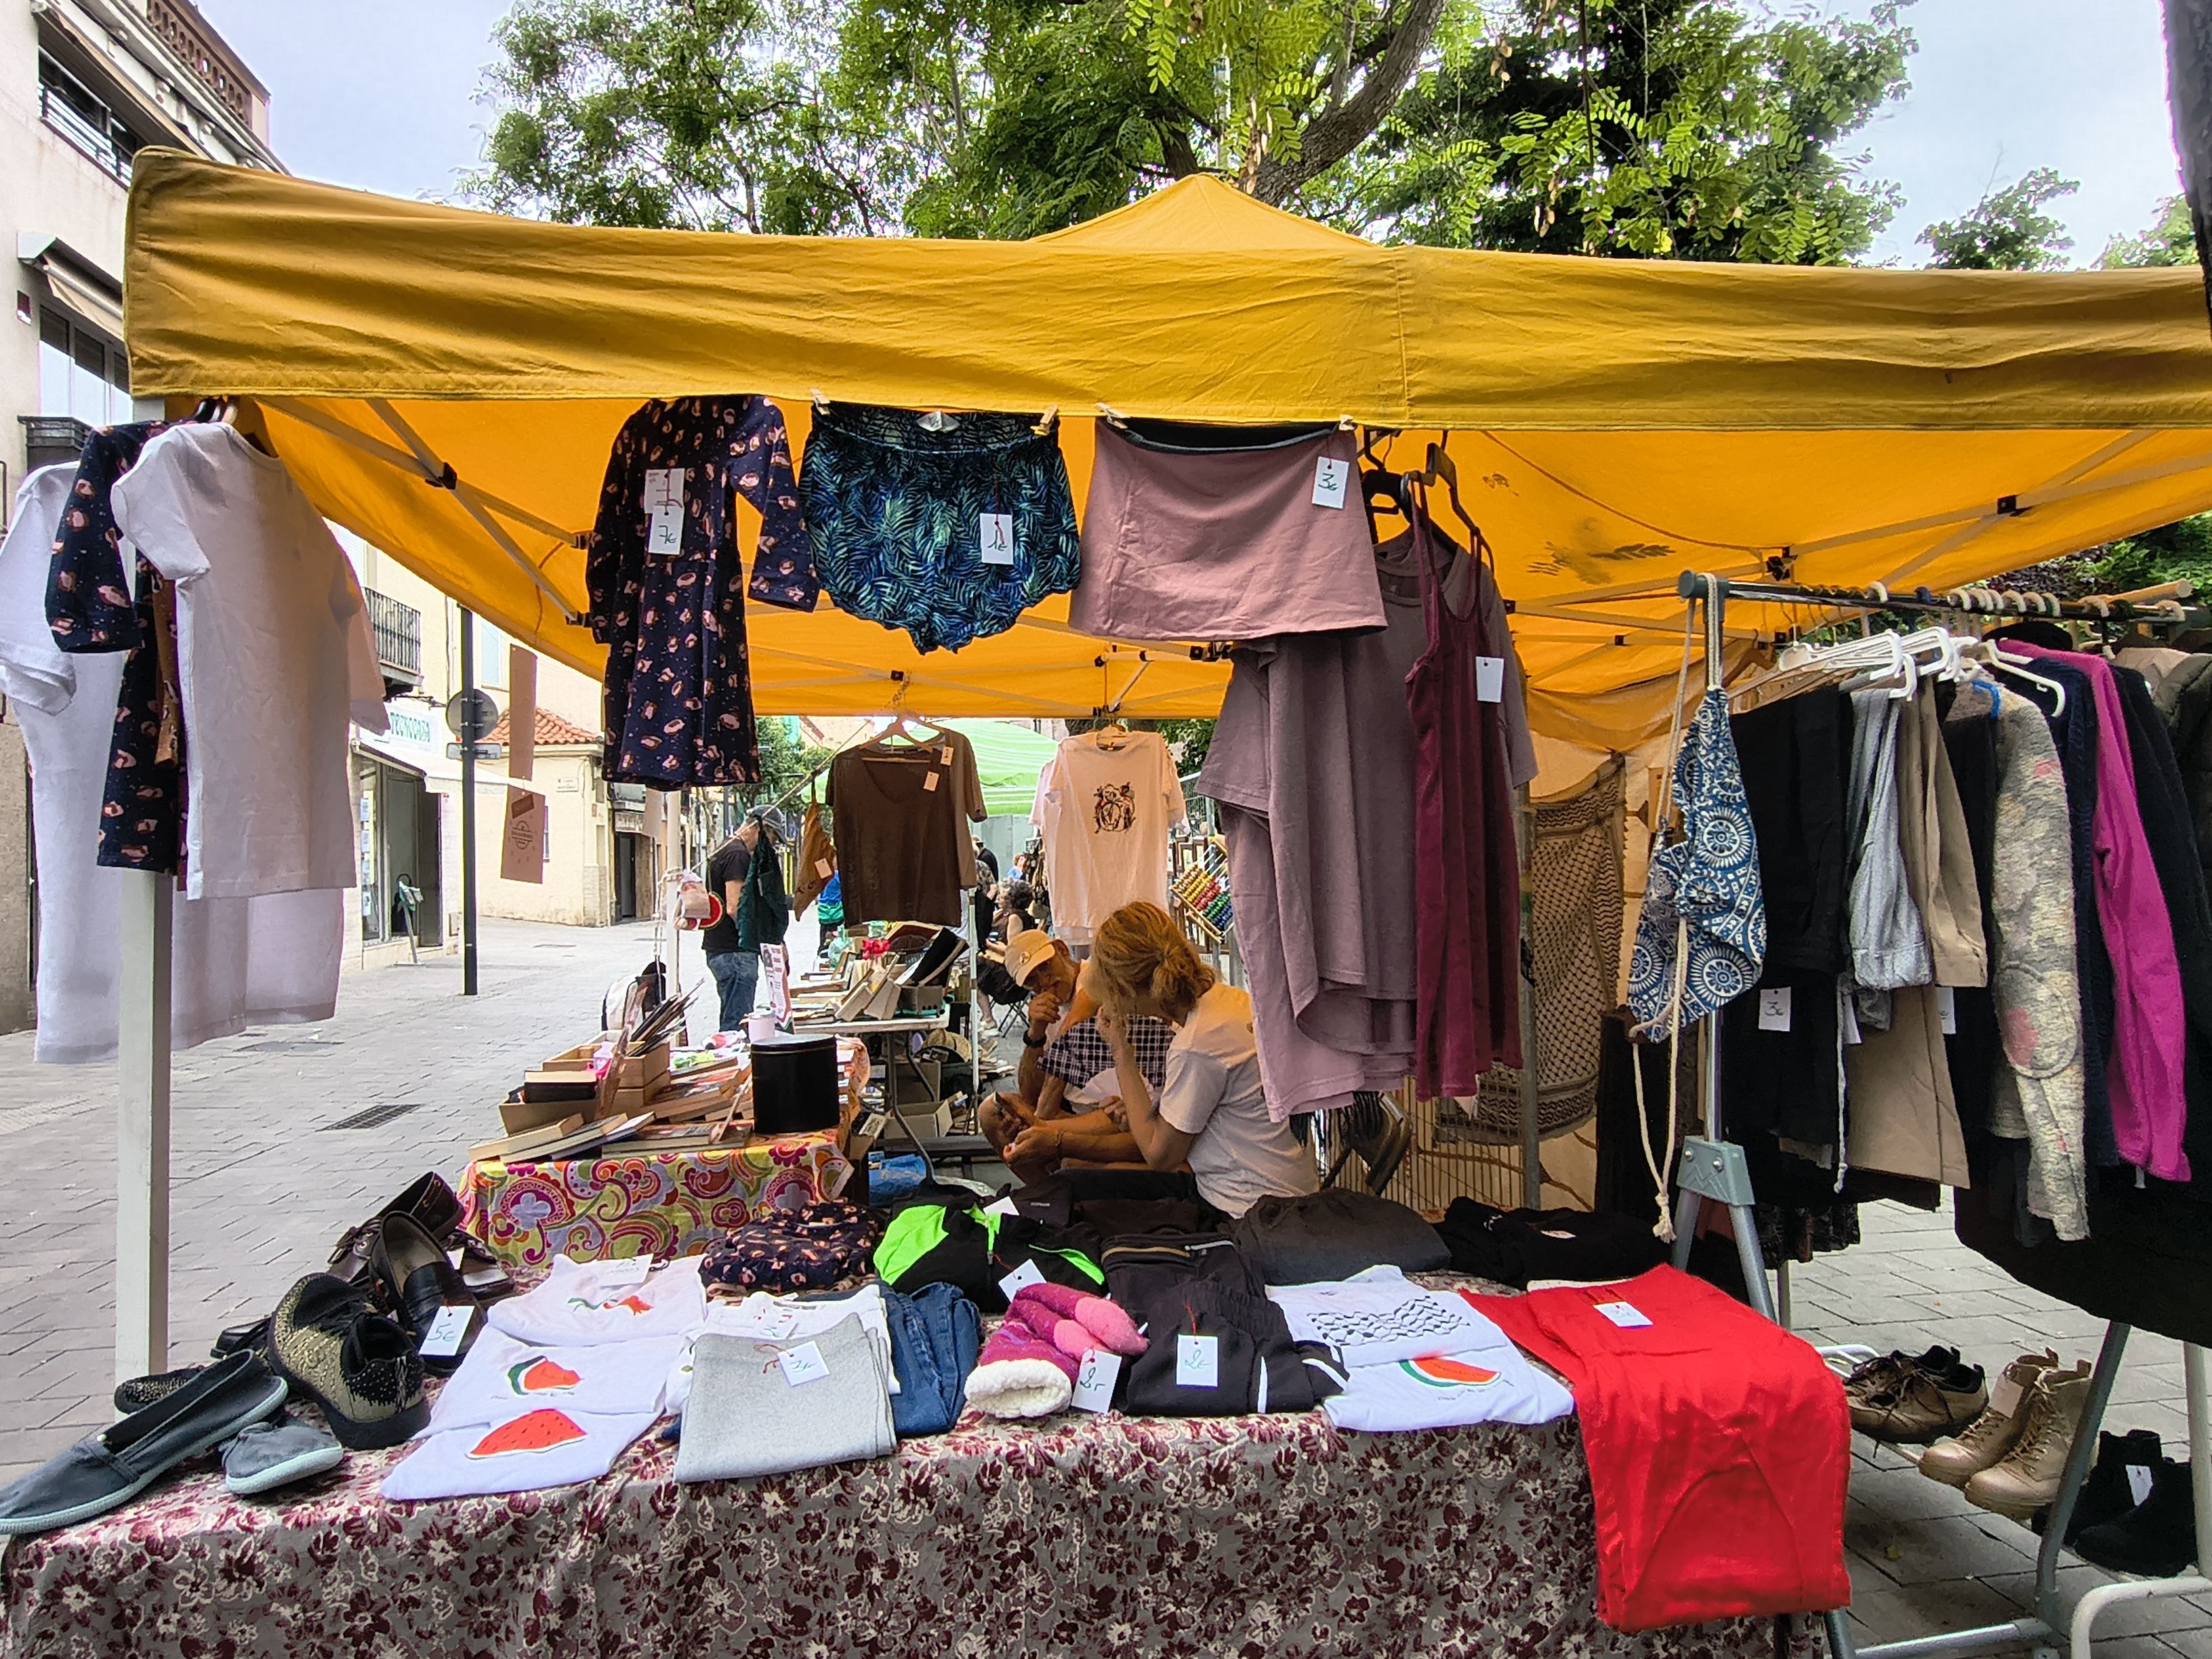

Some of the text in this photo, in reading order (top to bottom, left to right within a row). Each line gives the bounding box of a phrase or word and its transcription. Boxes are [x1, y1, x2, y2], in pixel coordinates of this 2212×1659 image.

[1318, 472, 1338, 491] 3€
[659, 525, 677, 544] 7€
[987, 529, 1008, 551] 1€
[428, 1323, 456, 1342] 5€
[1185, 1349, 1212, 1369] 2€
